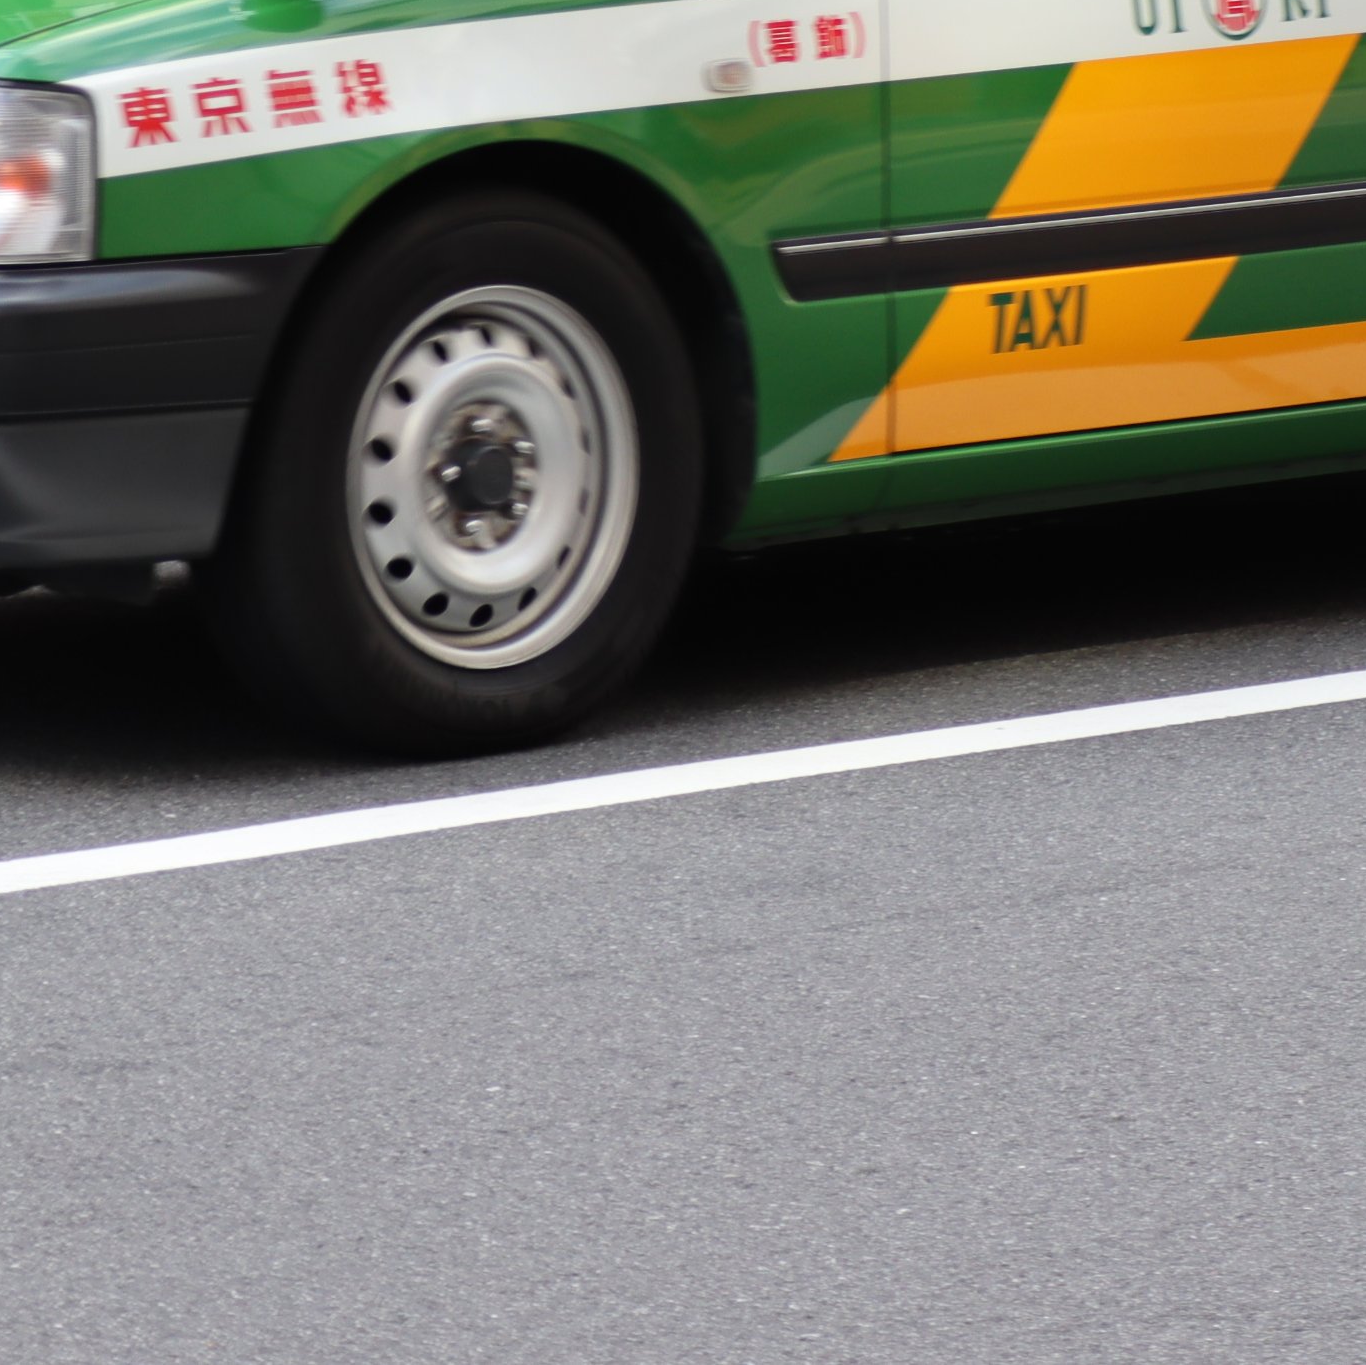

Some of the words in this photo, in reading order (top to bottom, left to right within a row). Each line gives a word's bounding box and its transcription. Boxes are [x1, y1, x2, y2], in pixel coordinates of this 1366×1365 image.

[117, 58, 389, 148] 東京無線
[988, 284, 1087, 354] TAXI
